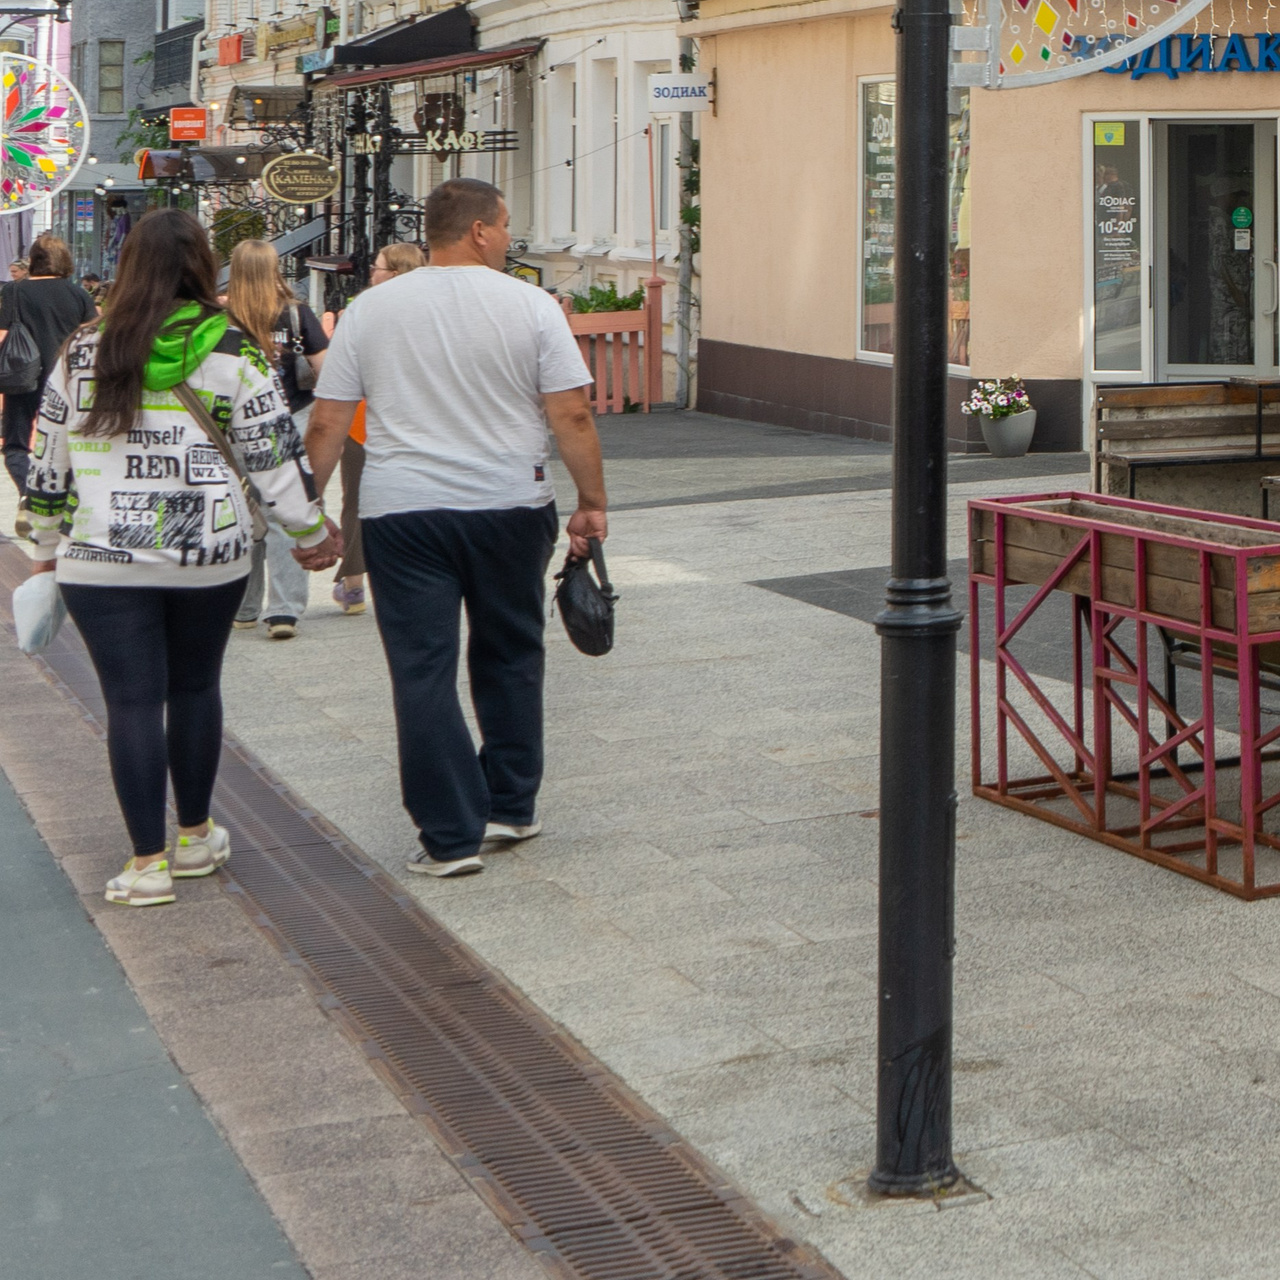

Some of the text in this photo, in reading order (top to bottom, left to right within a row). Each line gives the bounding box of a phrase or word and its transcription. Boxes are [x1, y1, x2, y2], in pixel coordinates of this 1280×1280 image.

[653, 85, 708, 99] ЗОДИАК
[425, 129, 486, 152] КАФЕ
[275, 174, 335, 184] КАМЕНКА
[1099, 195, 1136, 207] ZODIAC
[126, 426, 186, 450] myself
[76, 468, 102, 478] you
[124, 454, 181, 480] RED
[192, 467, 216, 478] WZ
[115, 494, 150, 510] WZ
[108, 509, 159, 527] RED
